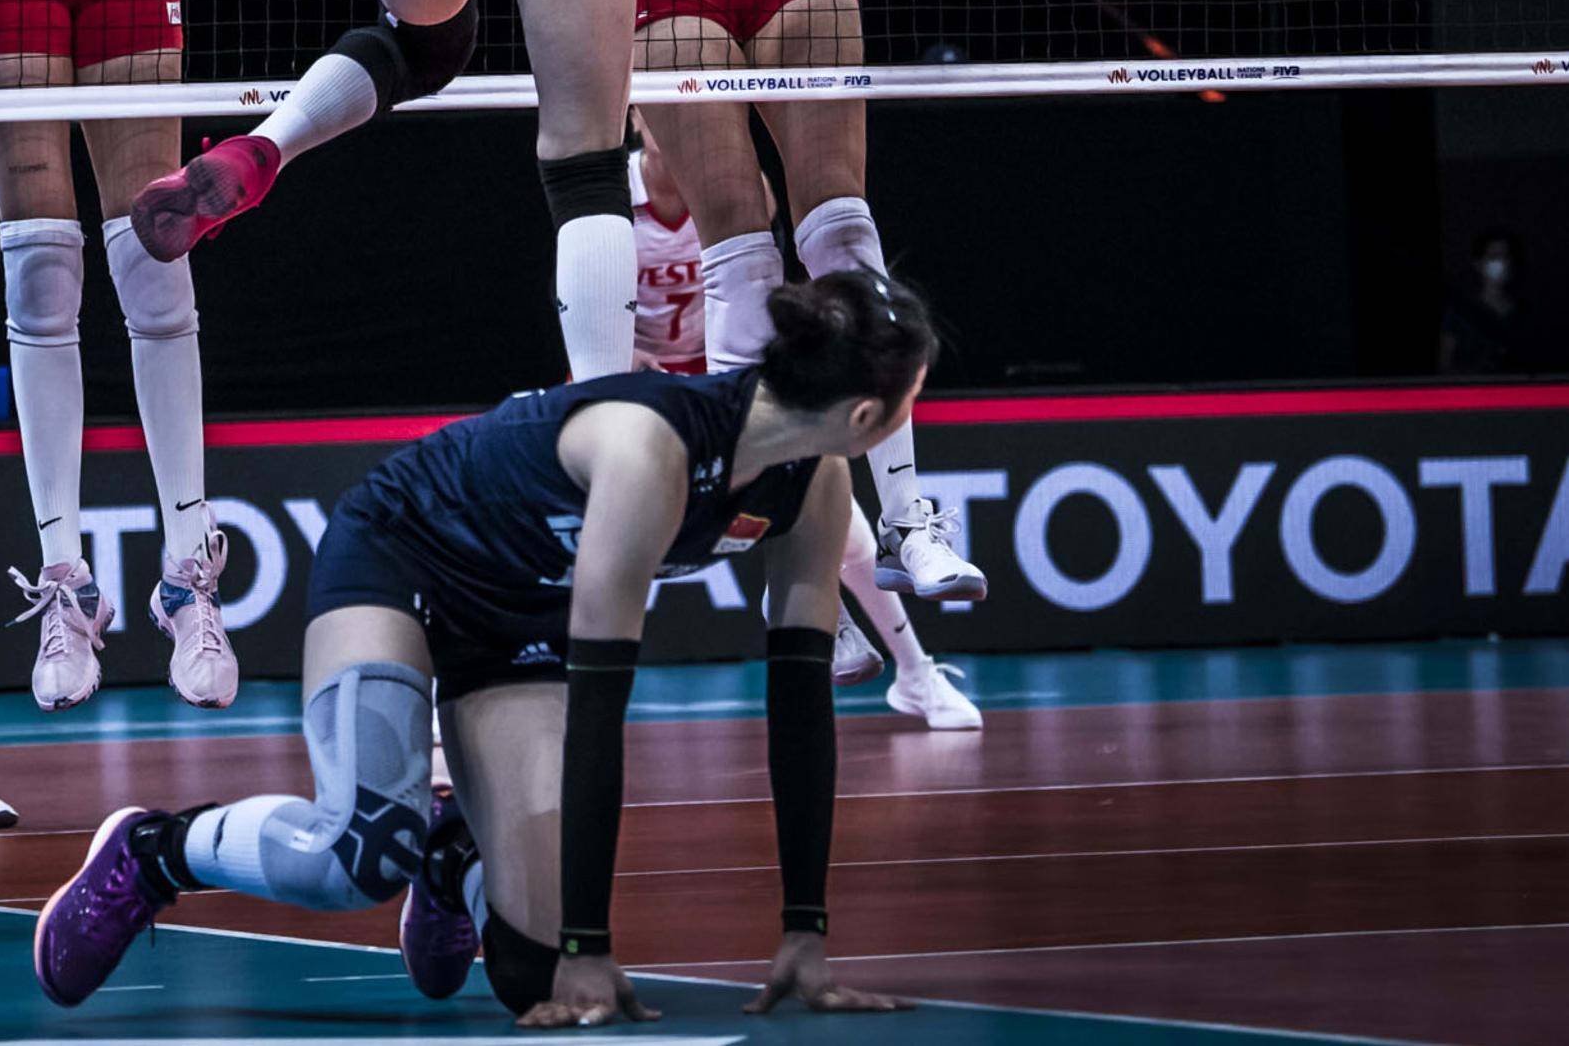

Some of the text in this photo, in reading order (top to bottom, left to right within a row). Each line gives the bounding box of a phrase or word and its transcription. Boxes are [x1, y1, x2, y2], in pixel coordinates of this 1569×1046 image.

[1107, 67, 1235, 84] VNL VOLLEYBALL
[1273, 66, 1301, 76] FIVB
[677, 77, 805, 94] VNL VOLLEYBALL
[844, 75, 872, 86] FIVB
[239, 88, 265, 105] VNL
[666, 292, 697, 342] 7
